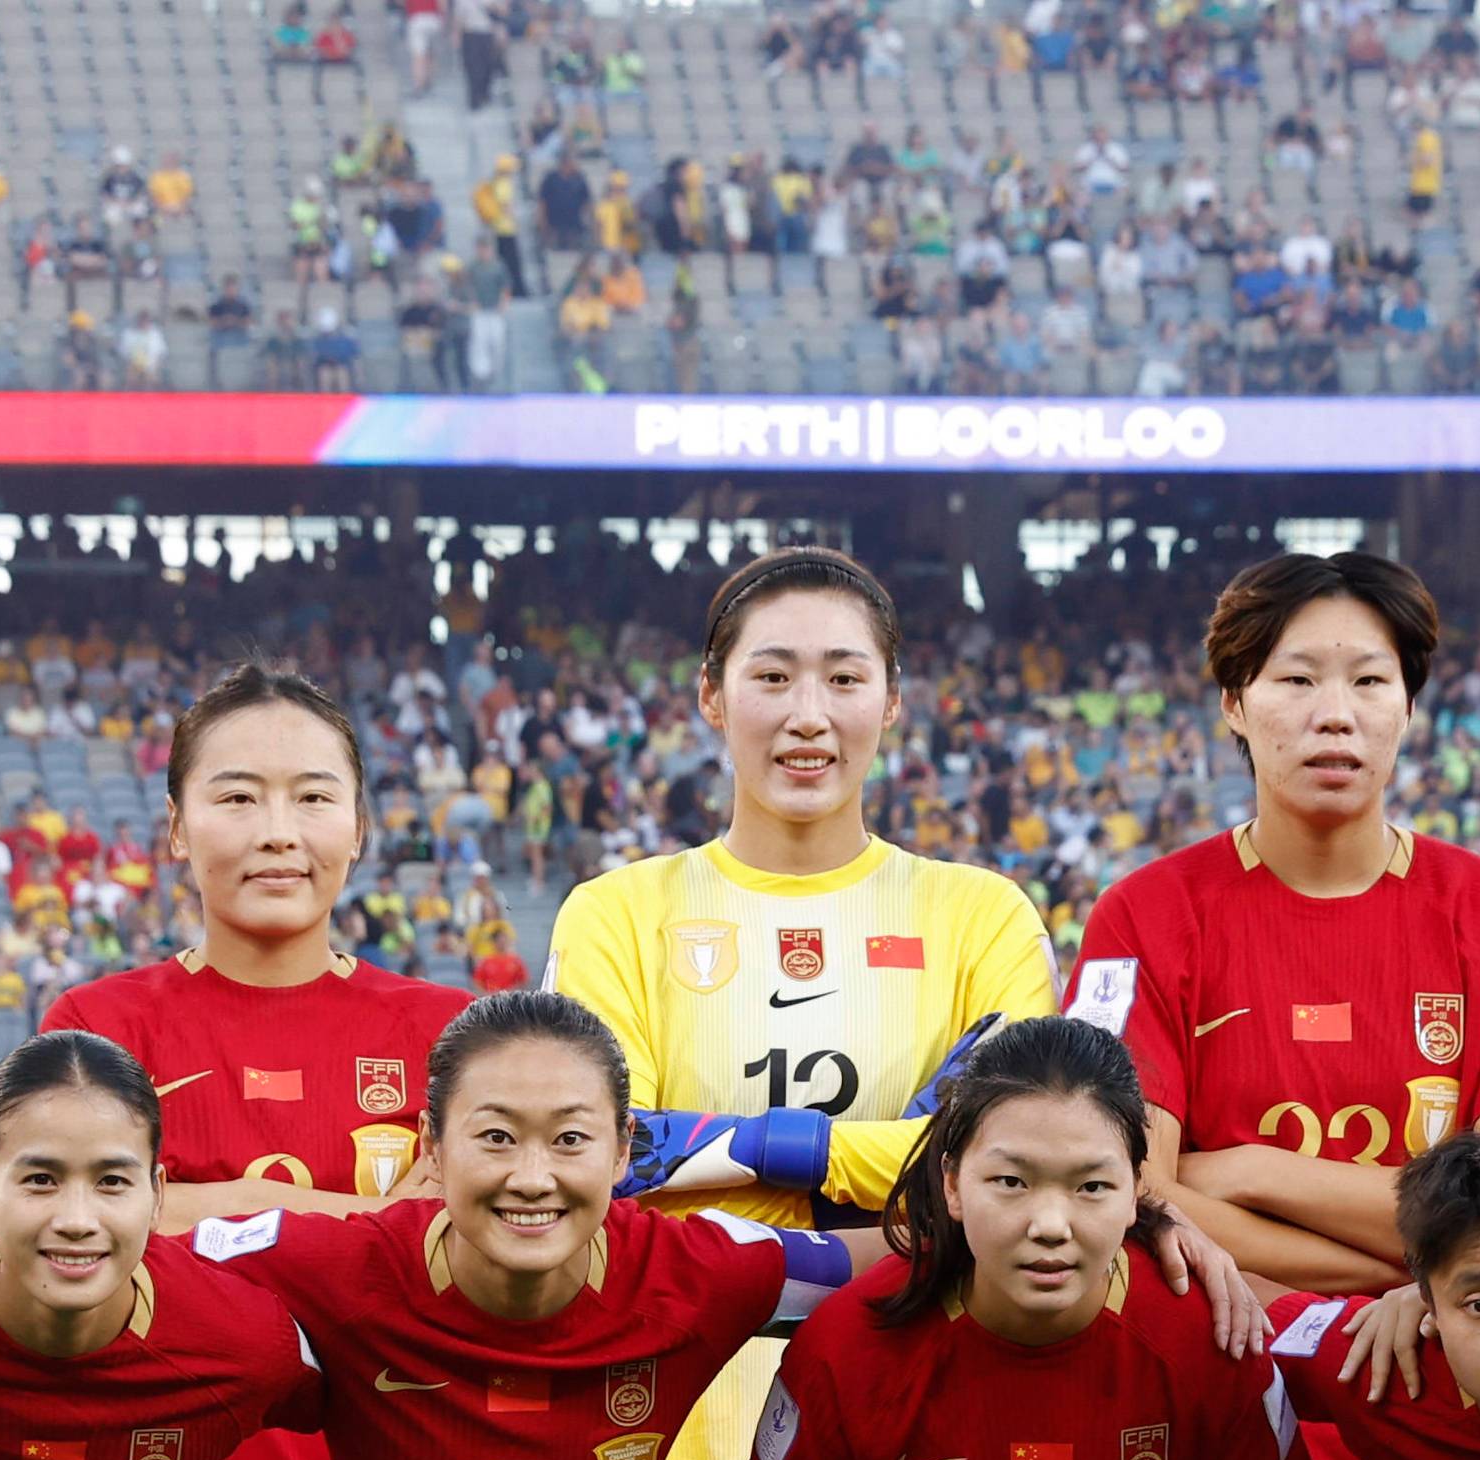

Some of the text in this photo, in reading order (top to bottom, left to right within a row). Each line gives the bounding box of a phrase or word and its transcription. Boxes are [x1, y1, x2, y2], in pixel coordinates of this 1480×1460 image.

[634, 404, 1226, 459] PERTH BOORLOO
[781, 930, 820, 942] CFA
[1420, 998, 1459, 1012] CFA
[360, 1062, 400, 1076] CFA
[610, 1362, 652, 1377] CFA
[136, 1432, 178, 1445] CFA
[1125, 1427, 1164, 1446] CFA
